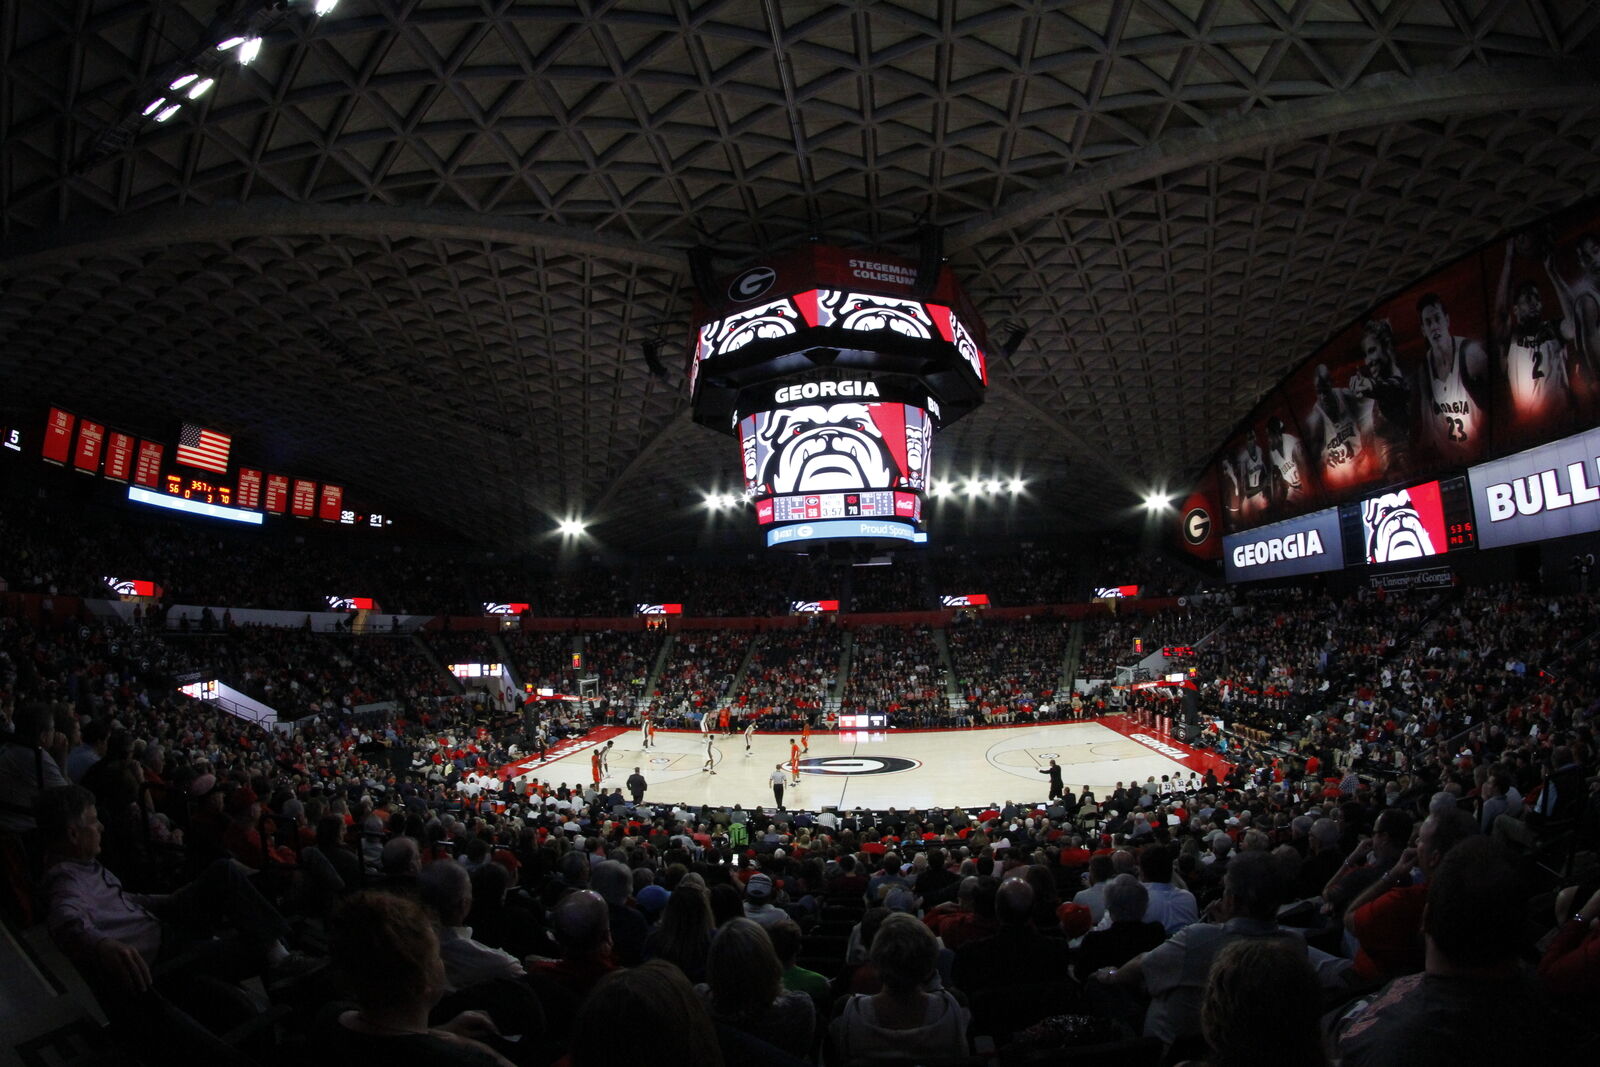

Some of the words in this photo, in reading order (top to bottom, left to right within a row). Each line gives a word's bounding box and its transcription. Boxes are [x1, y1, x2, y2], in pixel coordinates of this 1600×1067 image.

[848, 259, 918, 277] STEGEMAN
[852, 269, 916, 286] COLISEUM
[1532, 351, 1545, 379] 2
[775, 380, 880, 403] GEORGIA
[1446, 416, 1468, 442] 23
[10, 429, 20, 444] 5
[169, 483, 179, 493] 56
[1486, 457, 1600, 522] BULL
[220, 494, 230, 504] 70
[341, 510, 354, 520] 32
[823, 507, 842, 517] 3:57
[848, 506, 858, 515] 70
[370, 514, 382, 524] 21
[861, 524, 888, 534] Proud
[1233, 529, 1324, 568] GEORGIA
[1421, 571, 1451, 584] Georgia
